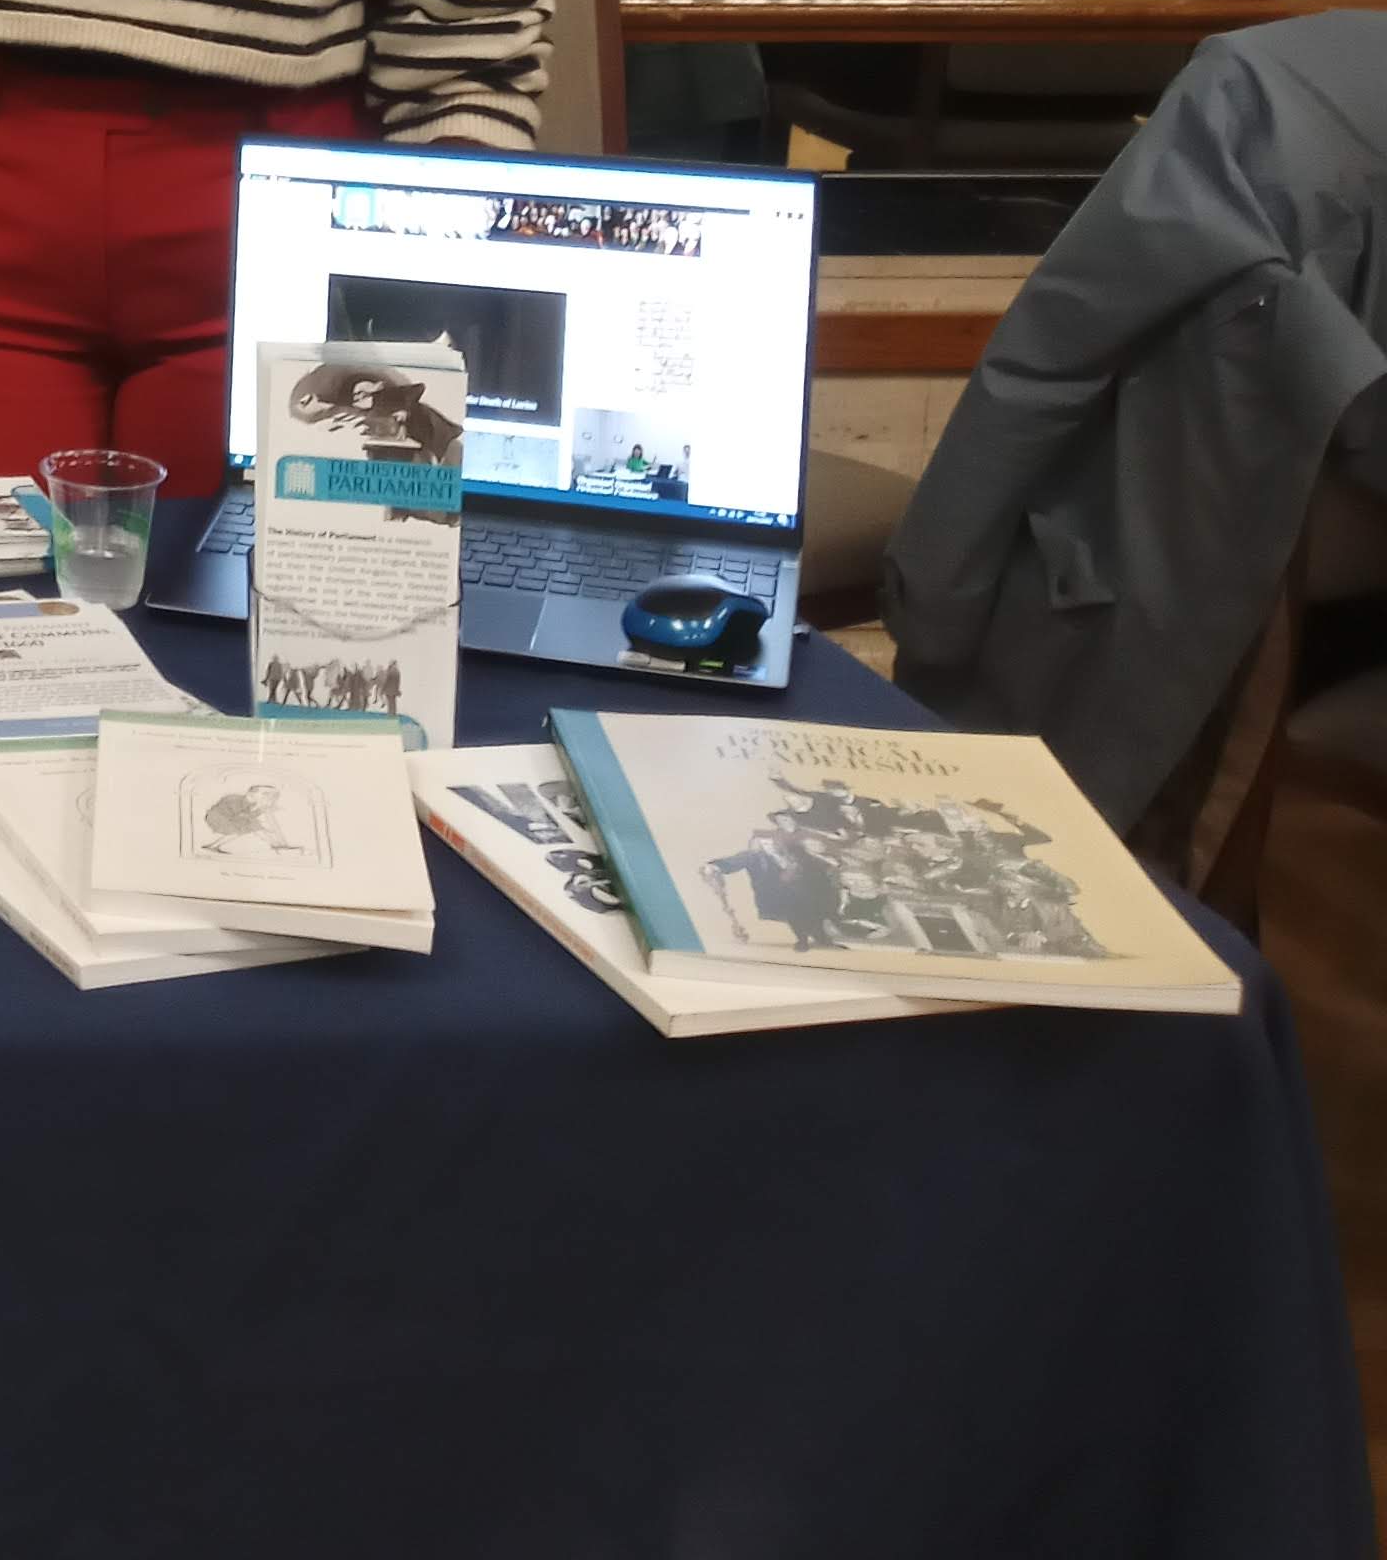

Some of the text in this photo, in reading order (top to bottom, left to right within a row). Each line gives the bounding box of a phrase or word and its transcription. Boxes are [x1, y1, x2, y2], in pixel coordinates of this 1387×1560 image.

[329, 460, 454, 482] THE HISTORY OF
[327, 474, 456, 500] PARLIAMENT
